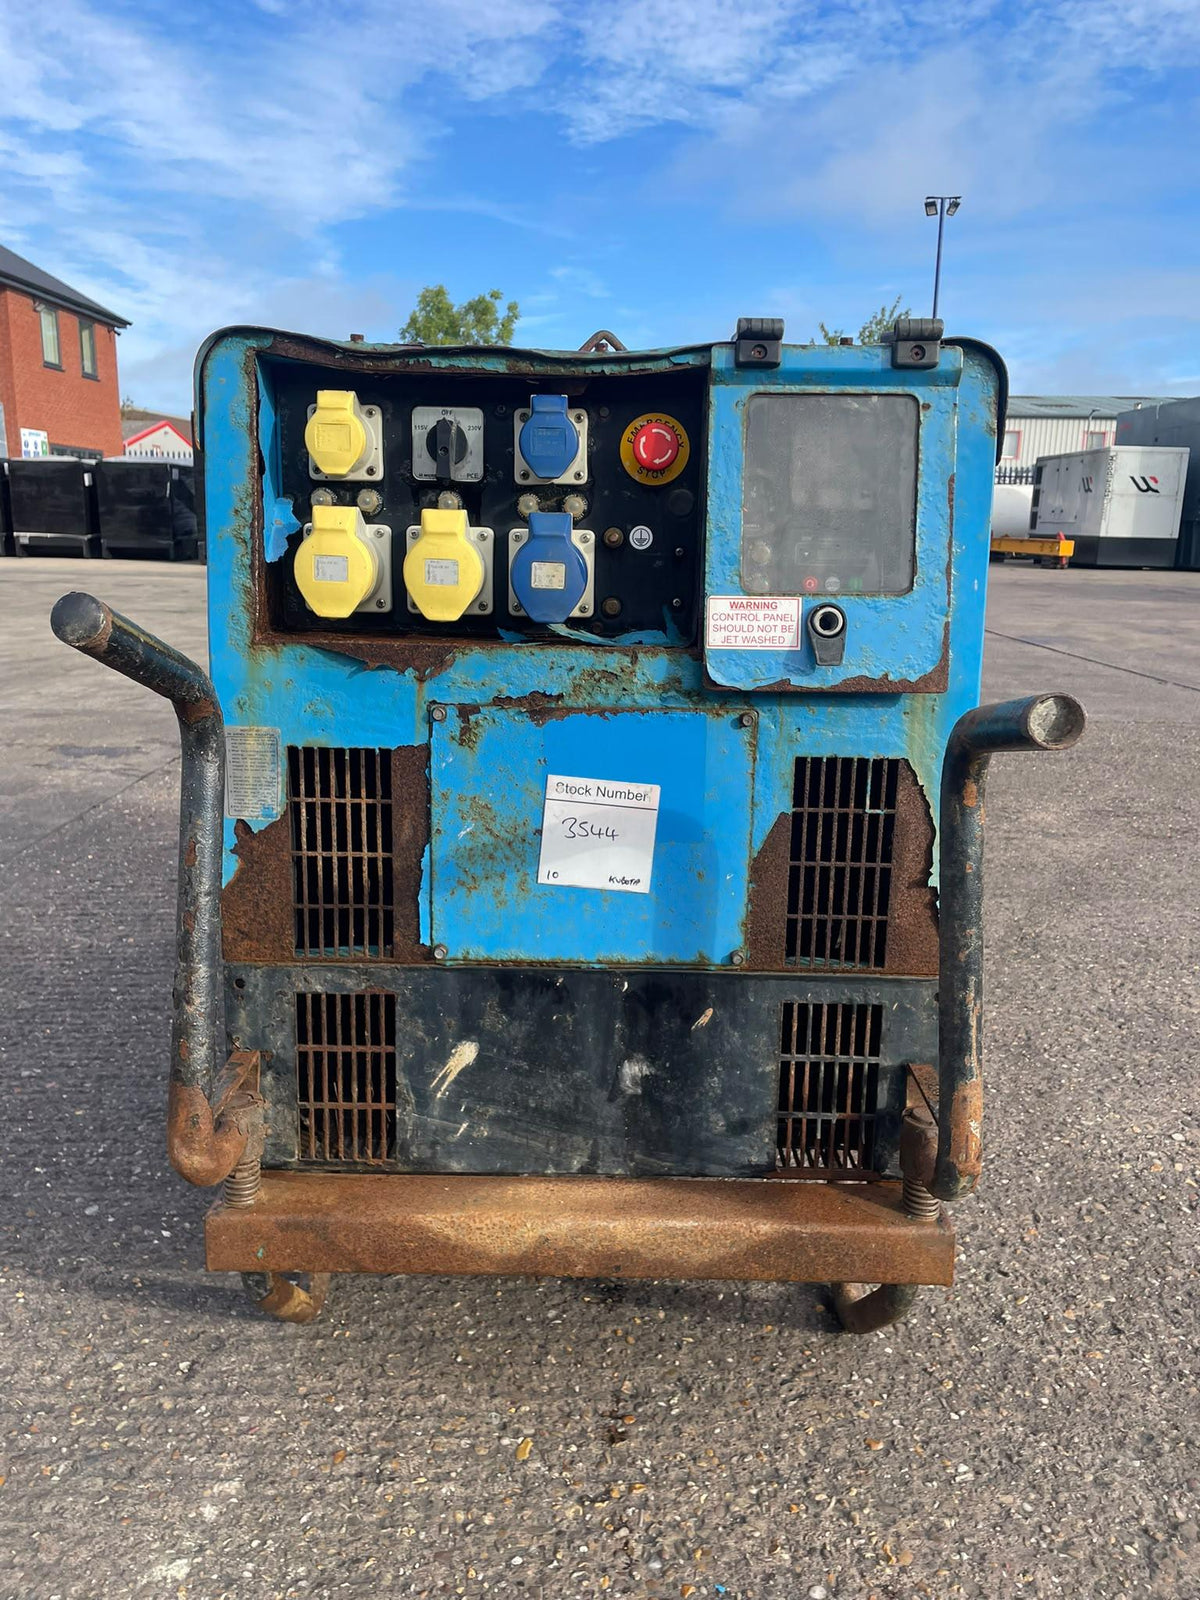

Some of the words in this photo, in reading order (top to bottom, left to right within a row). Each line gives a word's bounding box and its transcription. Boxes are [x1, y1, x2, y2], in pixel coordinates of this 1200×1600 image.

[637, 466, 666, 479] STOP
[729, 601, 778, 610] WARNING
[711, 613, 760, 622] CONTROL
[763, 614, 795, 622] PANEL
[712, 624, 755, 633] SHOULD
[757, 625, 778, 633] NOT
[781, 625, 794, 633] BE
[721, 636, 739, 644] JET
[741, 636, 786, 645] WASHED
[555, 781, 592, 796] Stock
[596, 786, 649, 802] Number
[562, 817, 619, 841] 3544
[546, 869, 559, 880] 10
